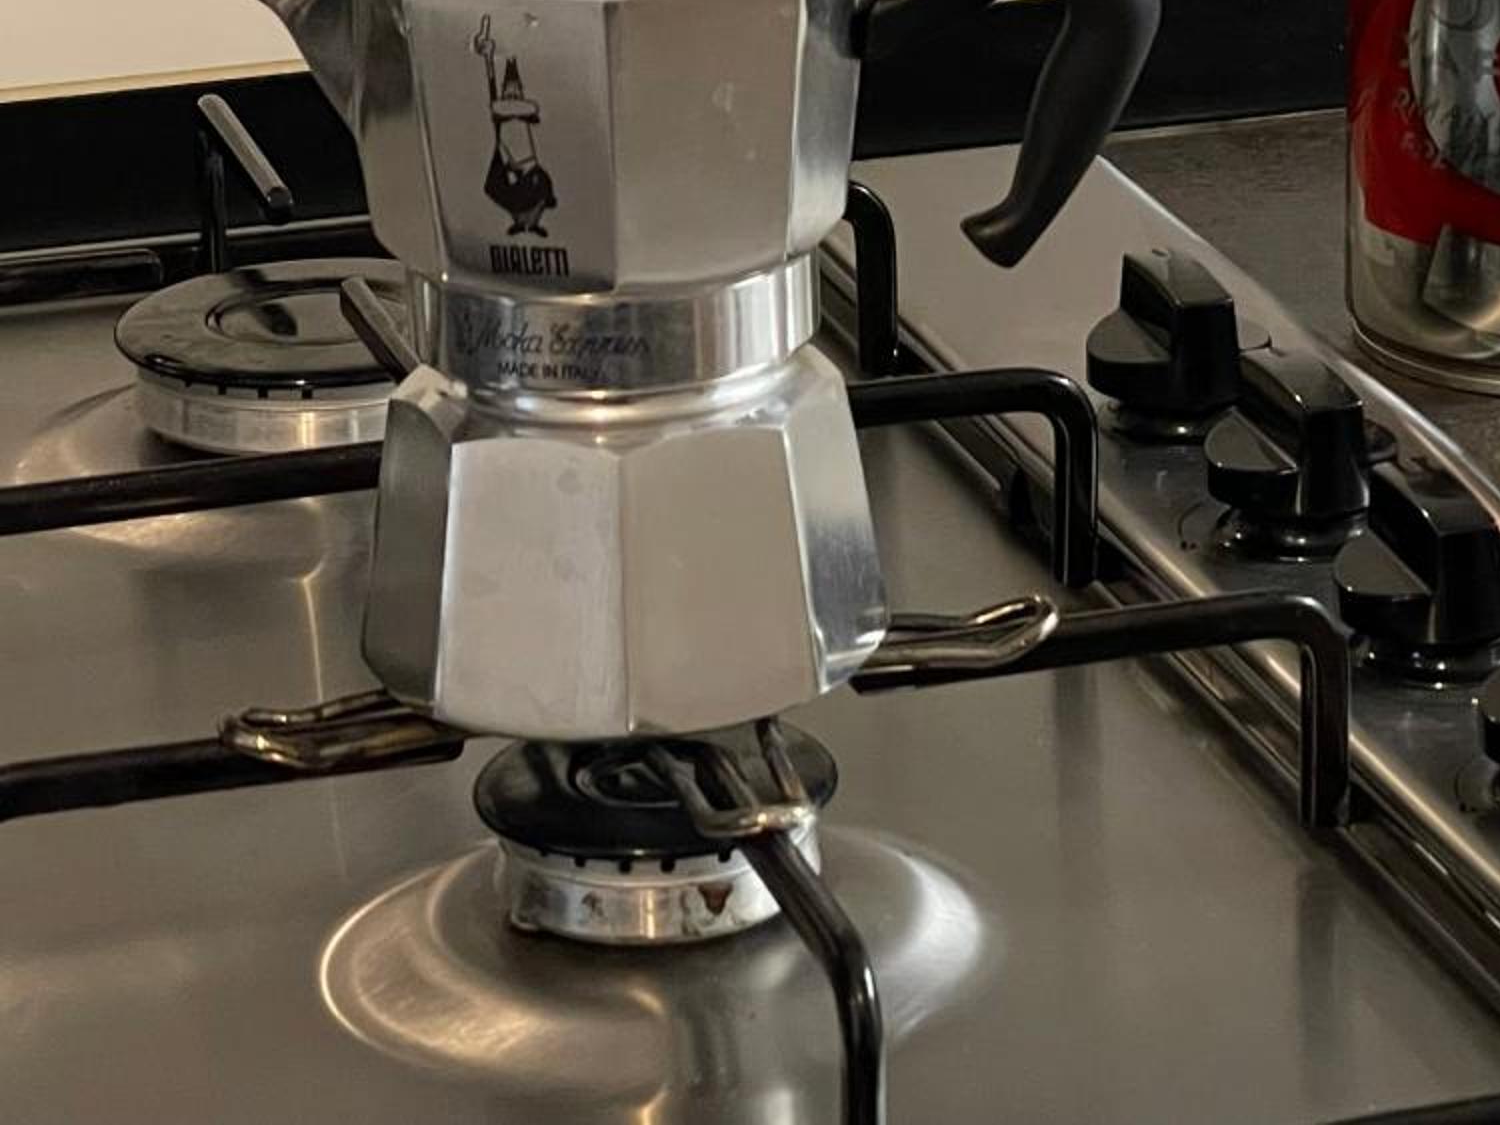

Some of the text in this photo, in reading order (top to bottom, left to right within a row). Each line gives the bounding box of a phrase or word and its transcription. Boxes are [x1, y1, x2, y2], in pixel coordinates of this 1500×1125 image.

[489, 244, 570, 277] BIALETTI
[498, 361, 537, 377] MADE
[543, 363, 559, 379] IN
